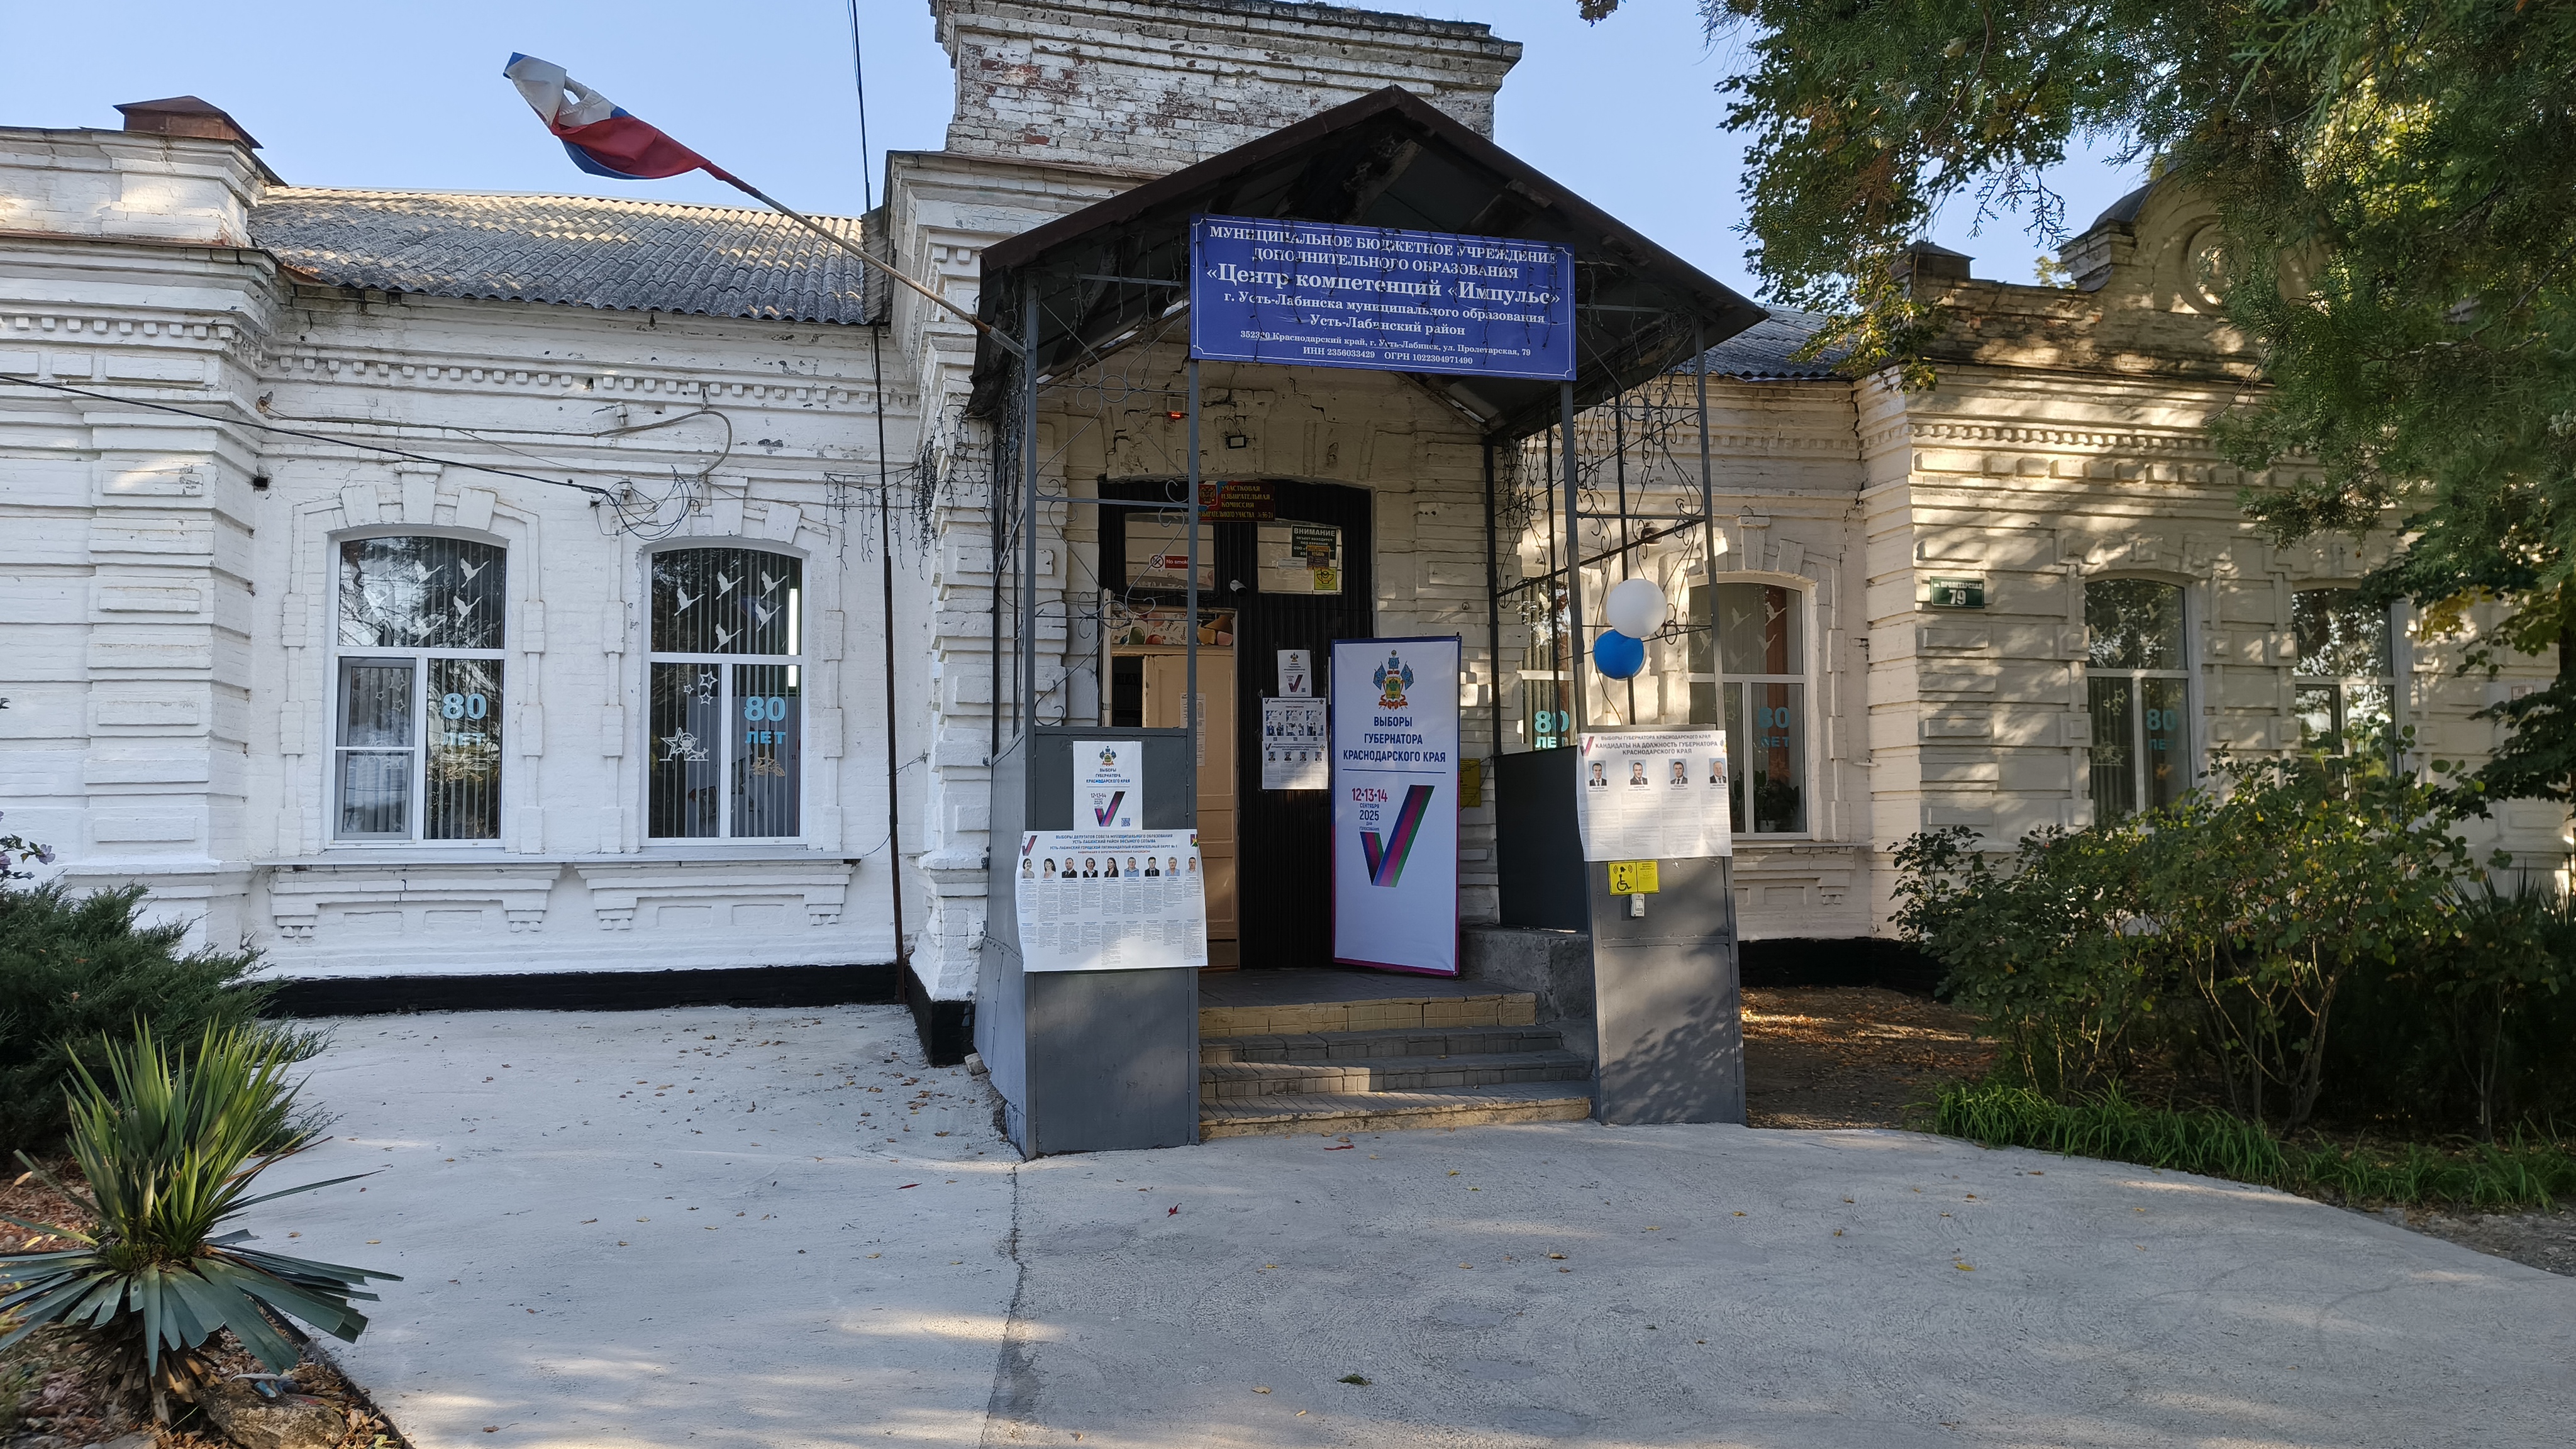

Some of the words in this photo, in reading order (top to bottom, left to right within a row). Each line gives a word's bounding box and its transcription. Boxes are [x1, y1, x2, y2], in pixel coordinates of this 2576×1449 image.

[1209, 226, 1352, 248] МУНИЦИПАЛЬНОЕ
[1355, 236, 1453, 256] БЮДЖЕТНОЕ
[1456, 245, 1558, 264] УЧРЕЖДЕНИЕ
[1252, 247, 1409, 270] ДОПОЛНИТЕЛЬНОГО
[1412, 260, 1519, 279] ОБРАЗОВАНИЯ
[1206, 262, 1289, 289] «Центр
[1296, 274, 1442, 297] компетенций
[1447, 280, 1560, 306] «Импульс»
[1224, 293, 1235, 302] г.
[1238, 291, 1343, 309] Усть-Лабинска
[1346, 302, 1459, 318] муниципального
[1462, 309, 1545, 324] образования
[1310, 314, 1422, 333] Усть-Лабинский
[1424, 322, 1465, 336] район
[1272, 332, 1341, 345] Краснодарский
[1344, 337, 1367, 347] край,
[1457, 345, 1519, 357] Пролетарская,
[1521, 348, 1531, 357] 79
[1303, 347, 1325, 355] ИНН
[1326, 348, 1375, 358] 2356033429
[1384, 352, 1410, 361] ОГРН
[1413, 353, 1473, 364] 1022304971490
[1294, 528, 1335, 536] ВНИМАНИЕ
[1949, 589, 1966, 605] 79
[443, 693, 487, 719] 80
[744, 696, 786, 721] 80
[1374, 716, 1413, 727] ВЫБОРЫ
[1535, 710, 1569, 733] 80
[1758, 707, 1790, 728] 80
[2146, 709, 2178, 731] 80
[441, 732, 486, 746] ЛЕТ
[745, 731, 786, 744] ЛЕТ
[1364, 733, 1423, 745] ГУБЕРНАТОРА
[1343, 750, 1421, 762] КРАСНОДАРСКОГО
[1423, 752, 1446, 763] КРАЯ
[1359, 809, 1379, 821] 2025
